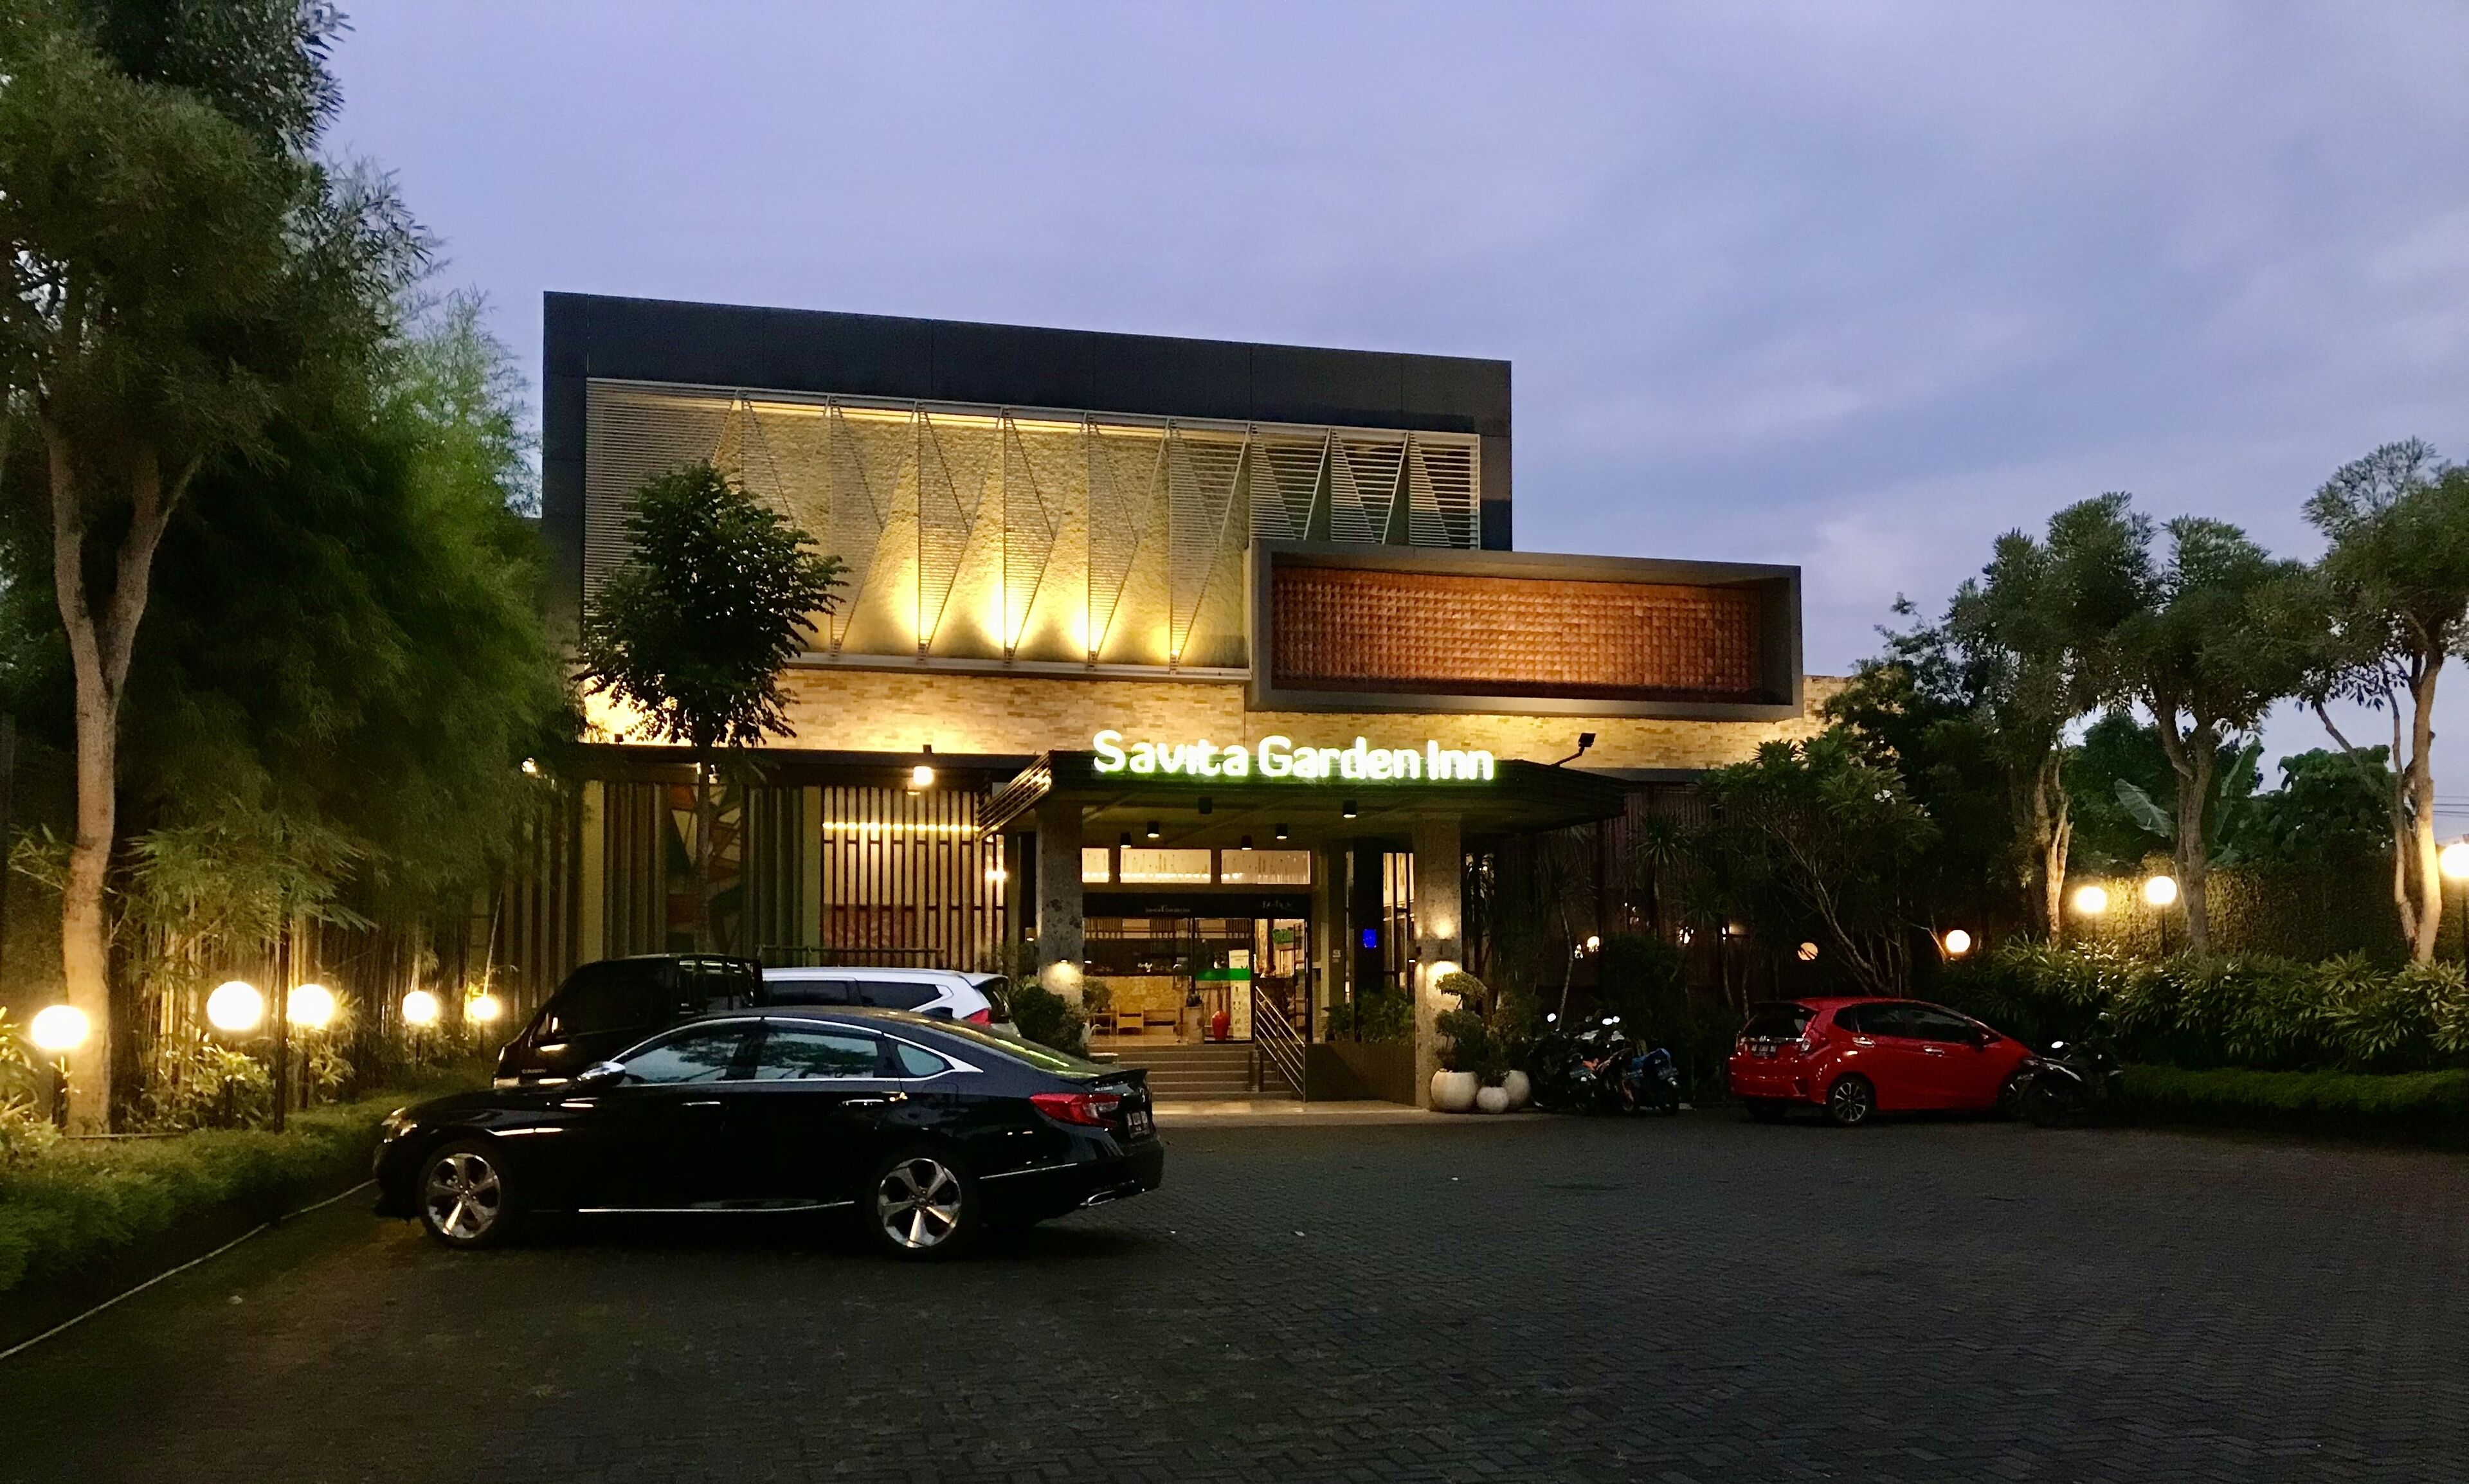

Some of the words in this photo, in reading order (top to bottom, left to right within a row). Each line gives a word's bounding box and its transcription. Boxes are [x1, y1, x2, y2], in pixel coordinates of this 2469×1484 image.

[1092, 729, 1249, 777] Savita
[1258, 735, 1421, 780] Garden
[1427, 739, 1495, 781] Inn
